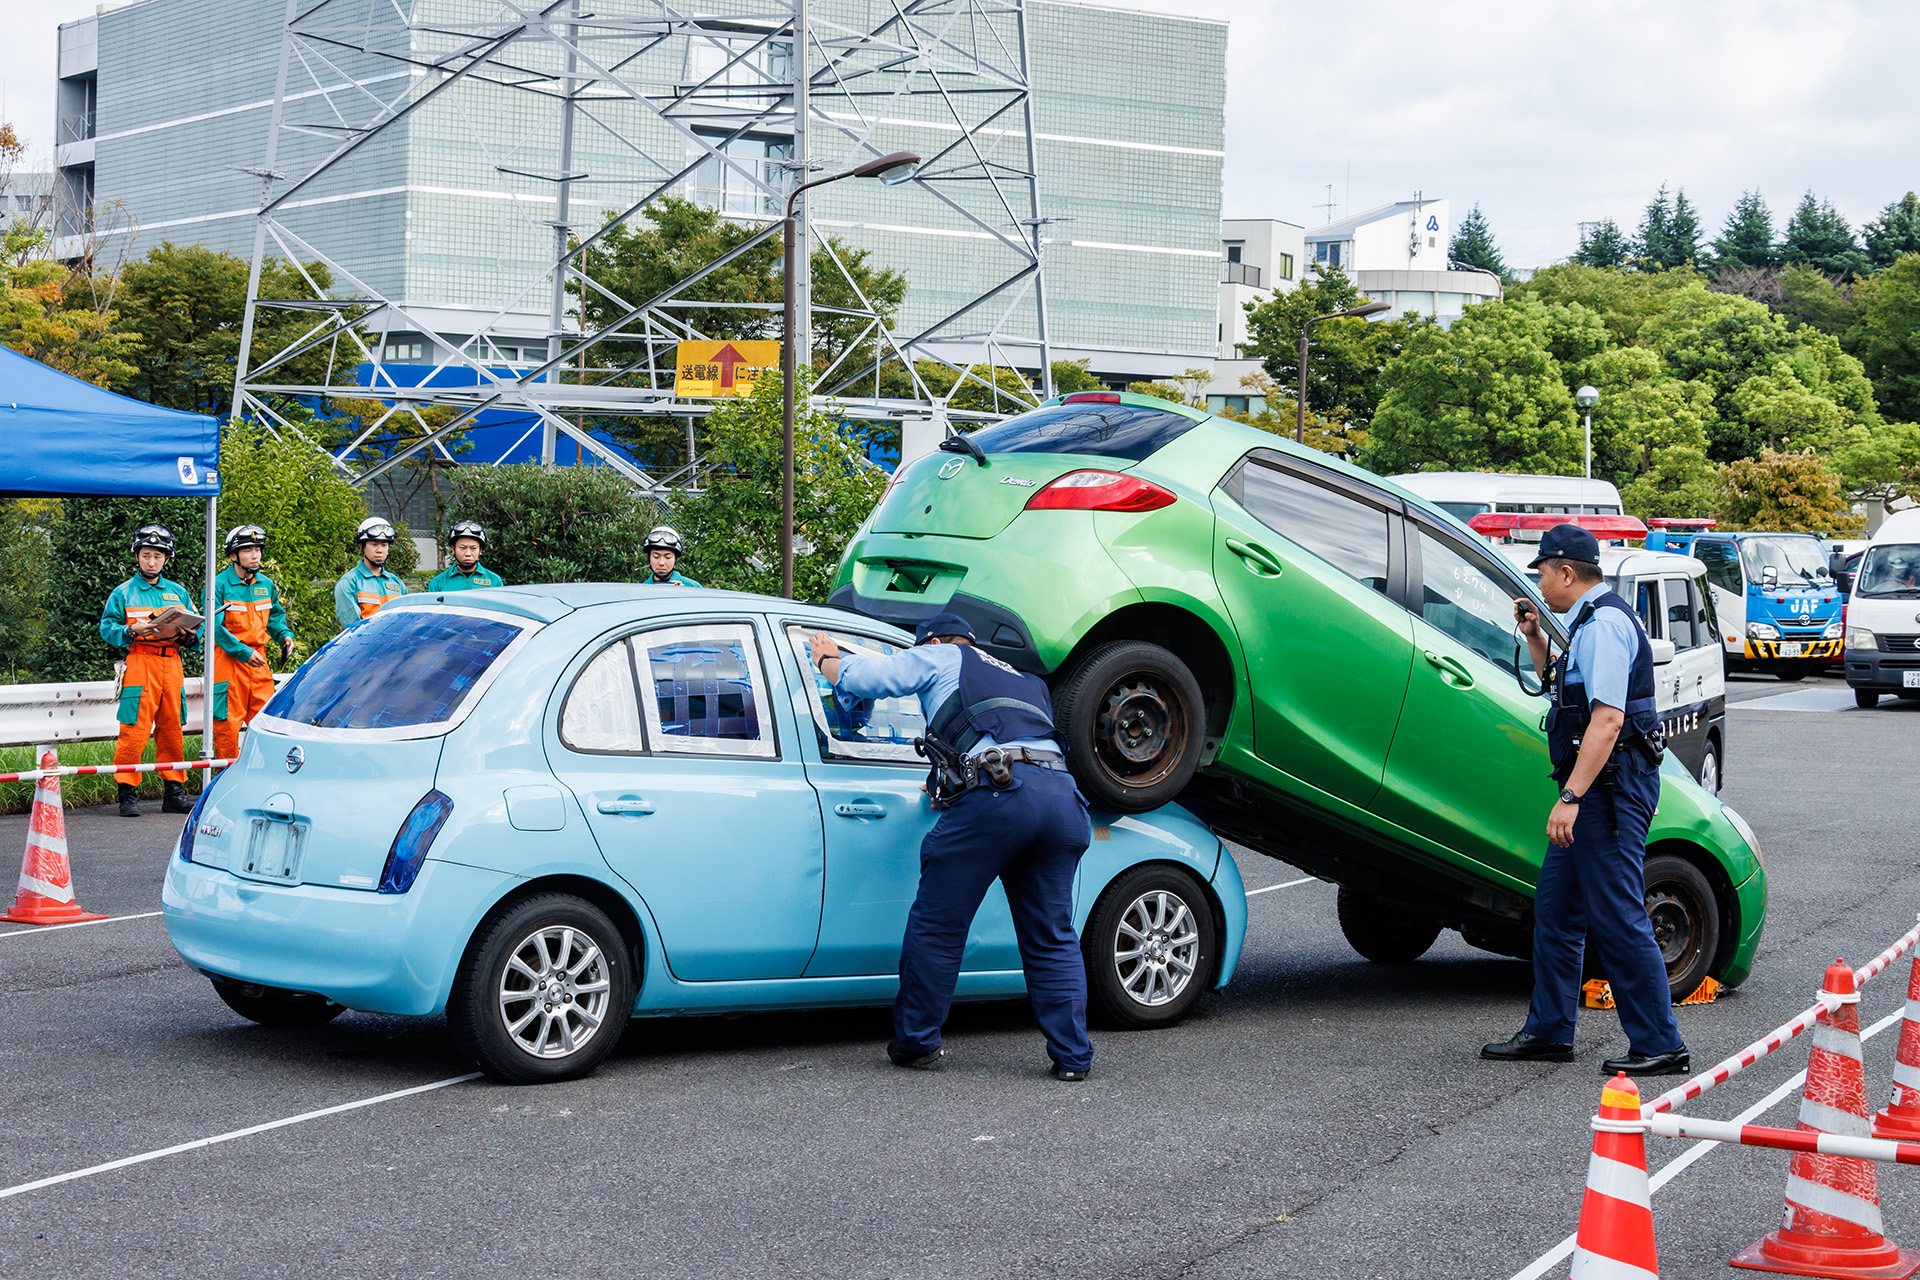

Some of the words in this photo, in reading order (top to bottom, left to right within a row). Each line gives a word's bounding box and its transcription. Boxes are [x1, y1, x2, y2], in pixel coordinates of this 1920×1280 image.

[681, 364, 719, 381] 送電線
[735, 365, 770, 381] に注
[1000, 476, 1036, 488] Demio
[1453, 567, 1495, 601] 62741
[1790, 599, 1819, 613] JAF
[1660, 711, 1698, 737] OLICE
